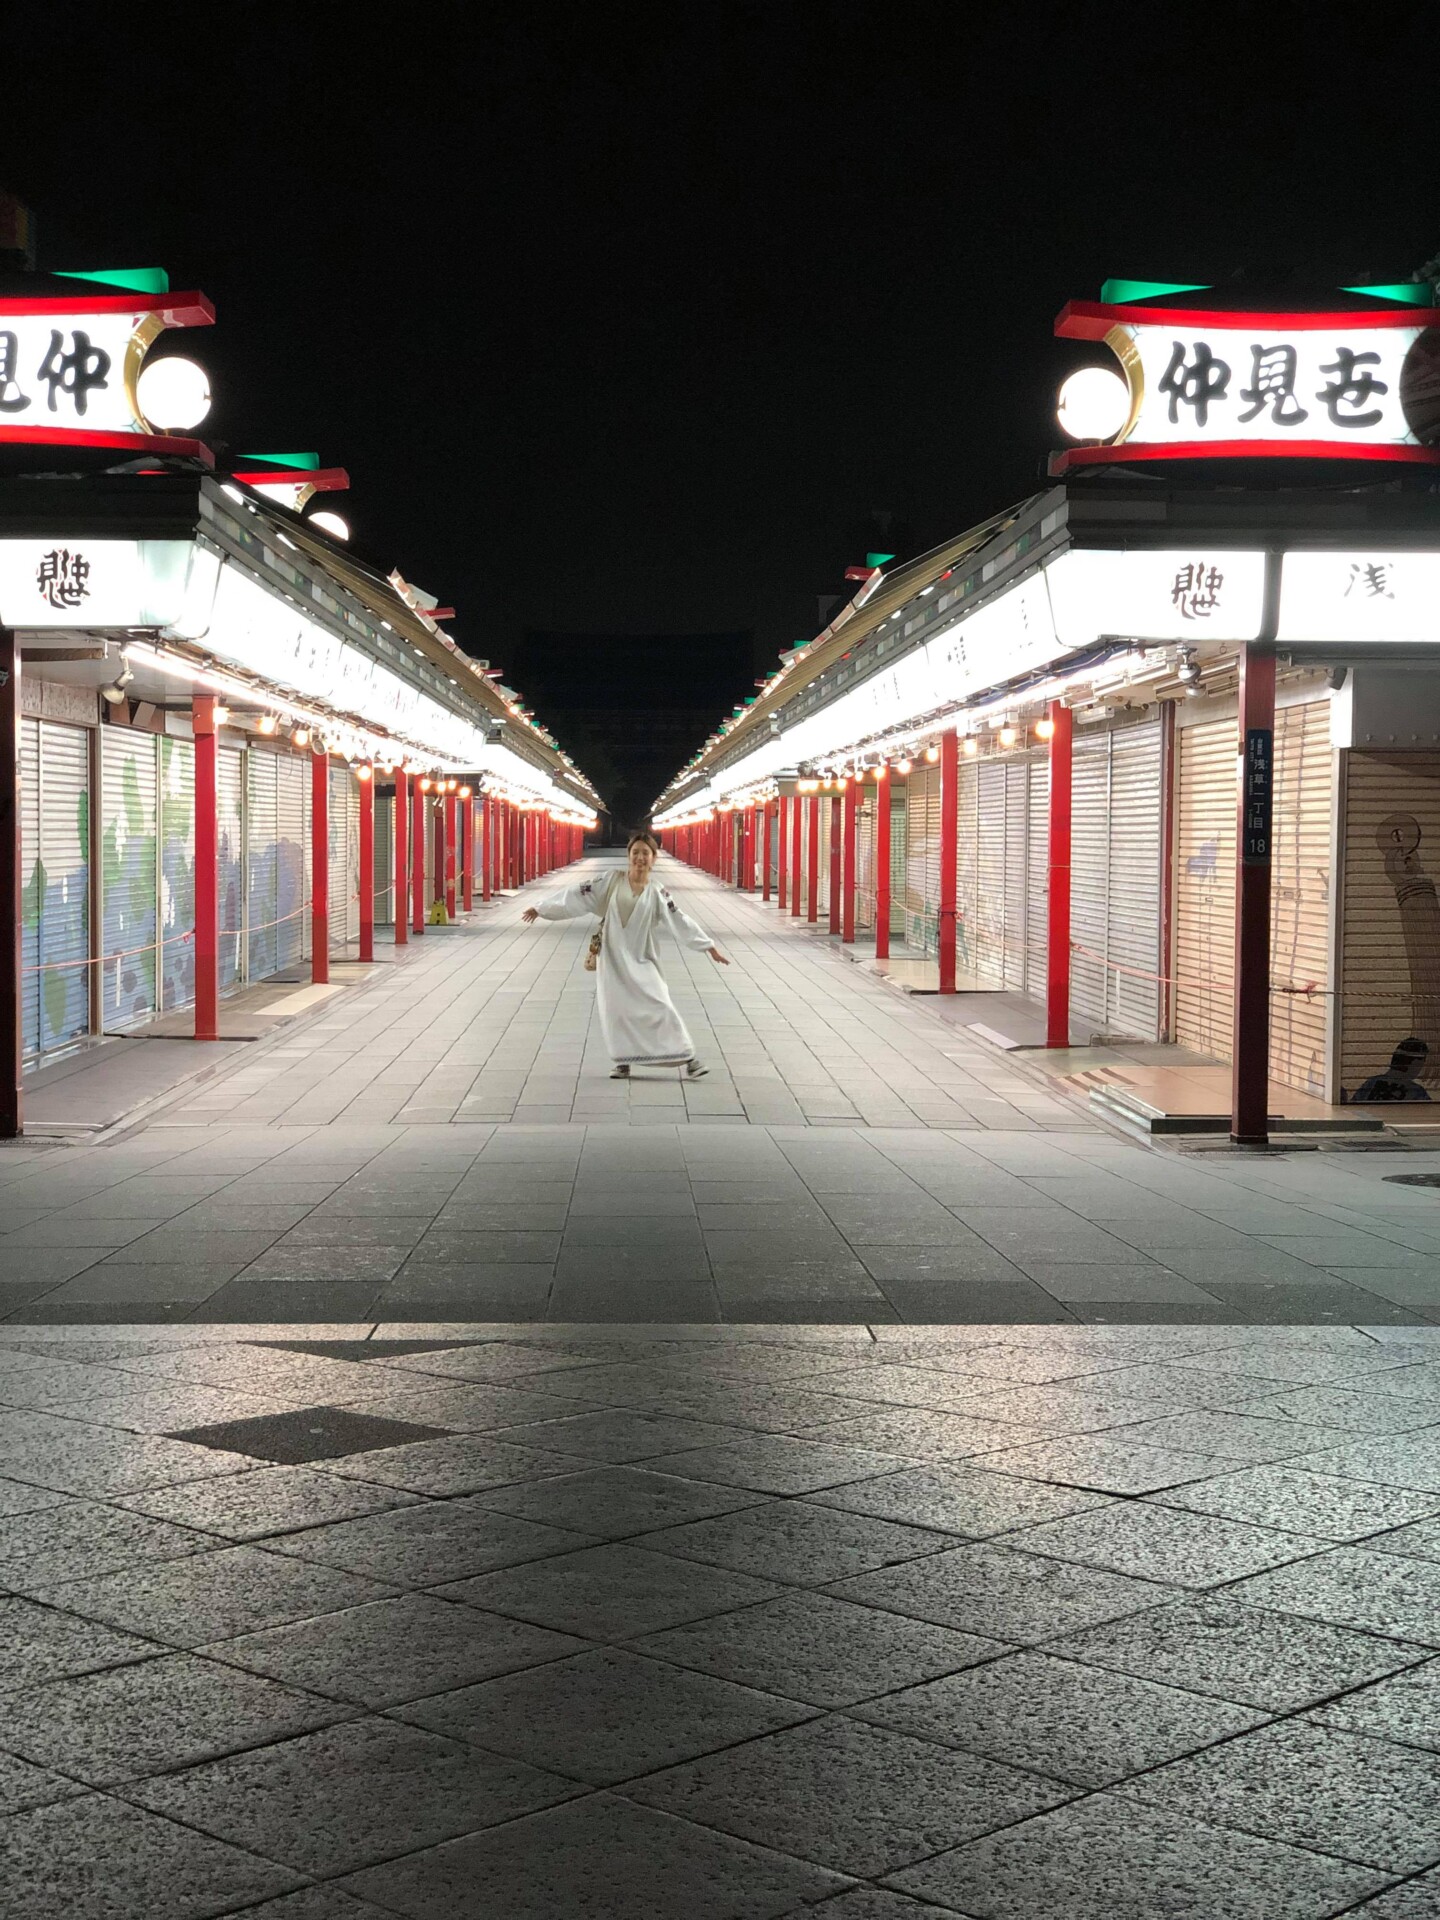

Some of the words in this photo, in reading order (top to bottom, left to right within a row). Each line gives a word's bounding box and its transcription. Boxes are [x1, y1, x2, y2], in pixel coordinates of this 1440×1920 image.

[1158, 341, 1388, 428] 仲見世
[1344, 563, 1395, 600] 浅
[1253, 758, 1265, 828] 浅草一丁目
[1250, 838, 1266, 853] 18
